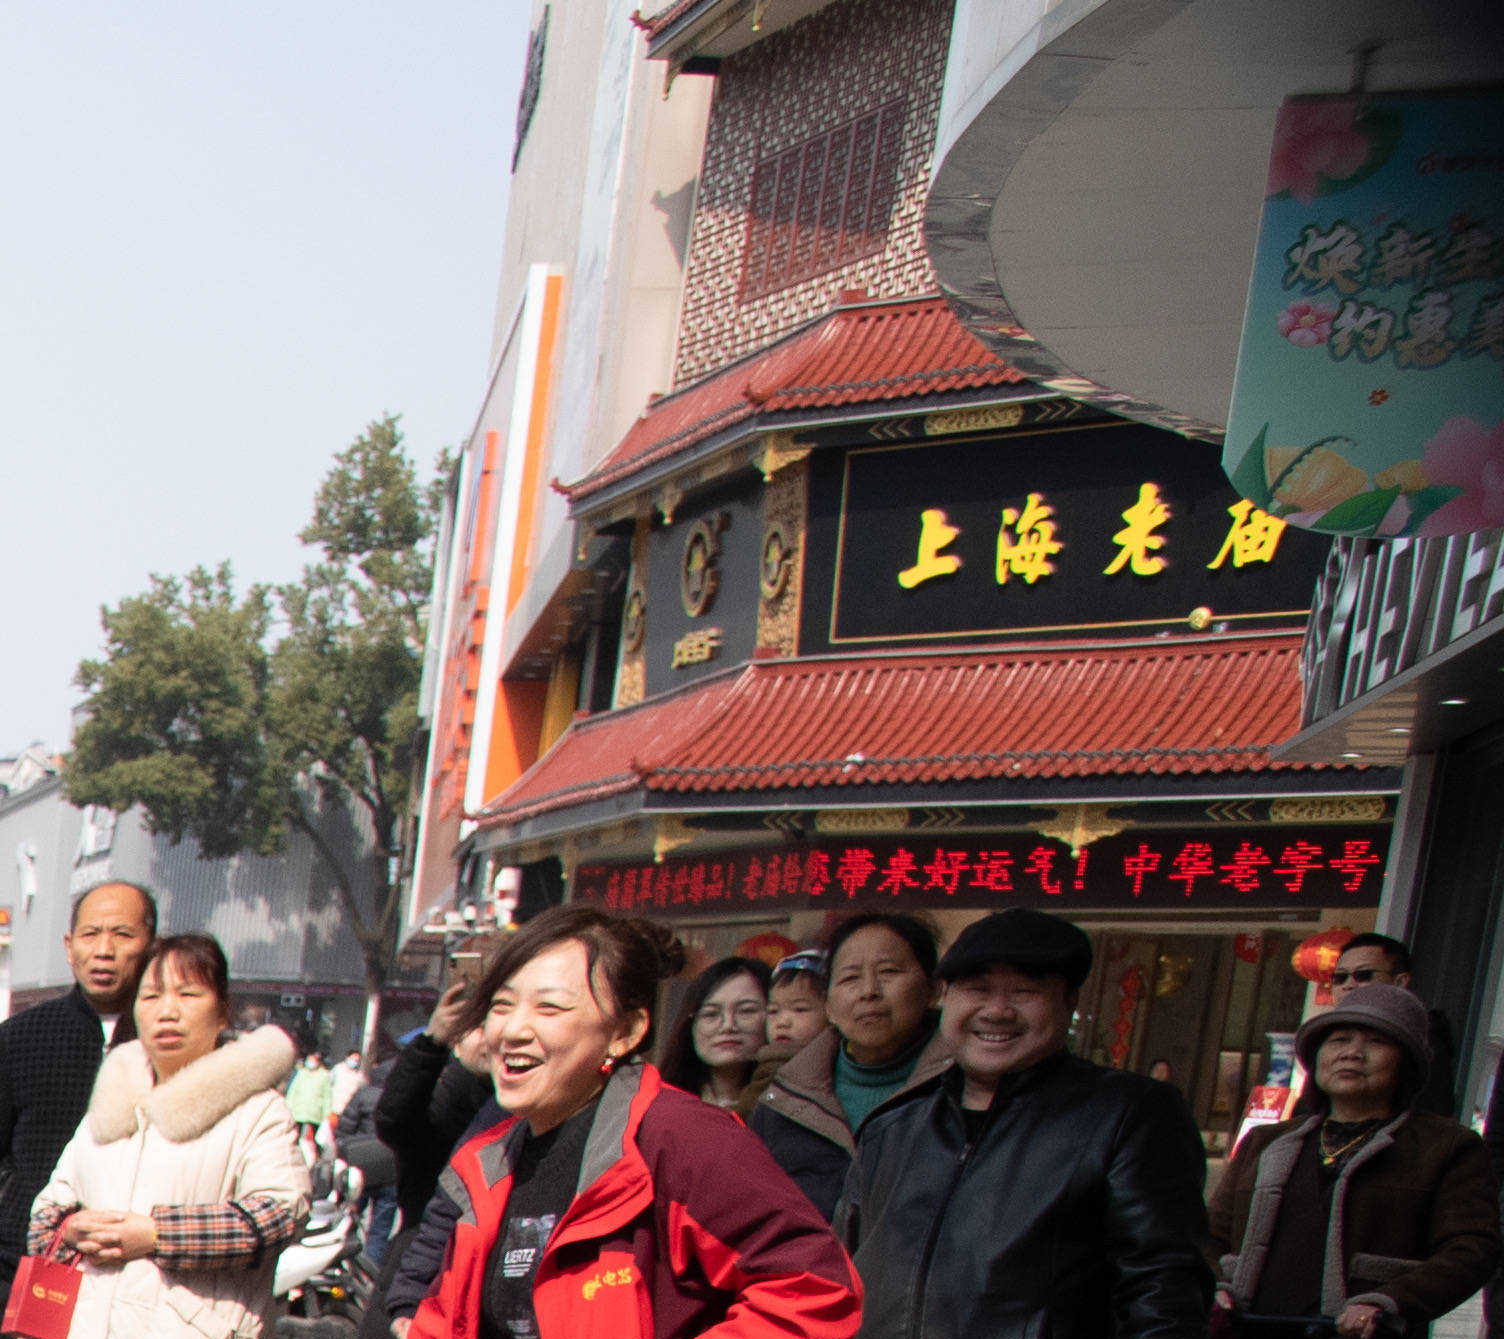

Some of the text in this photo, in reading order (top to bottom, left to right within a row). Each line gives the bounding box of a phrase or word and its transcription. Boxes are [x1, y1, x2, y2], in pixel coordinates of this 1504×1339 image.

[898, 482, 1288, 588] 上海老庙
[1124, 840, 1381, 897] 中华老字号
